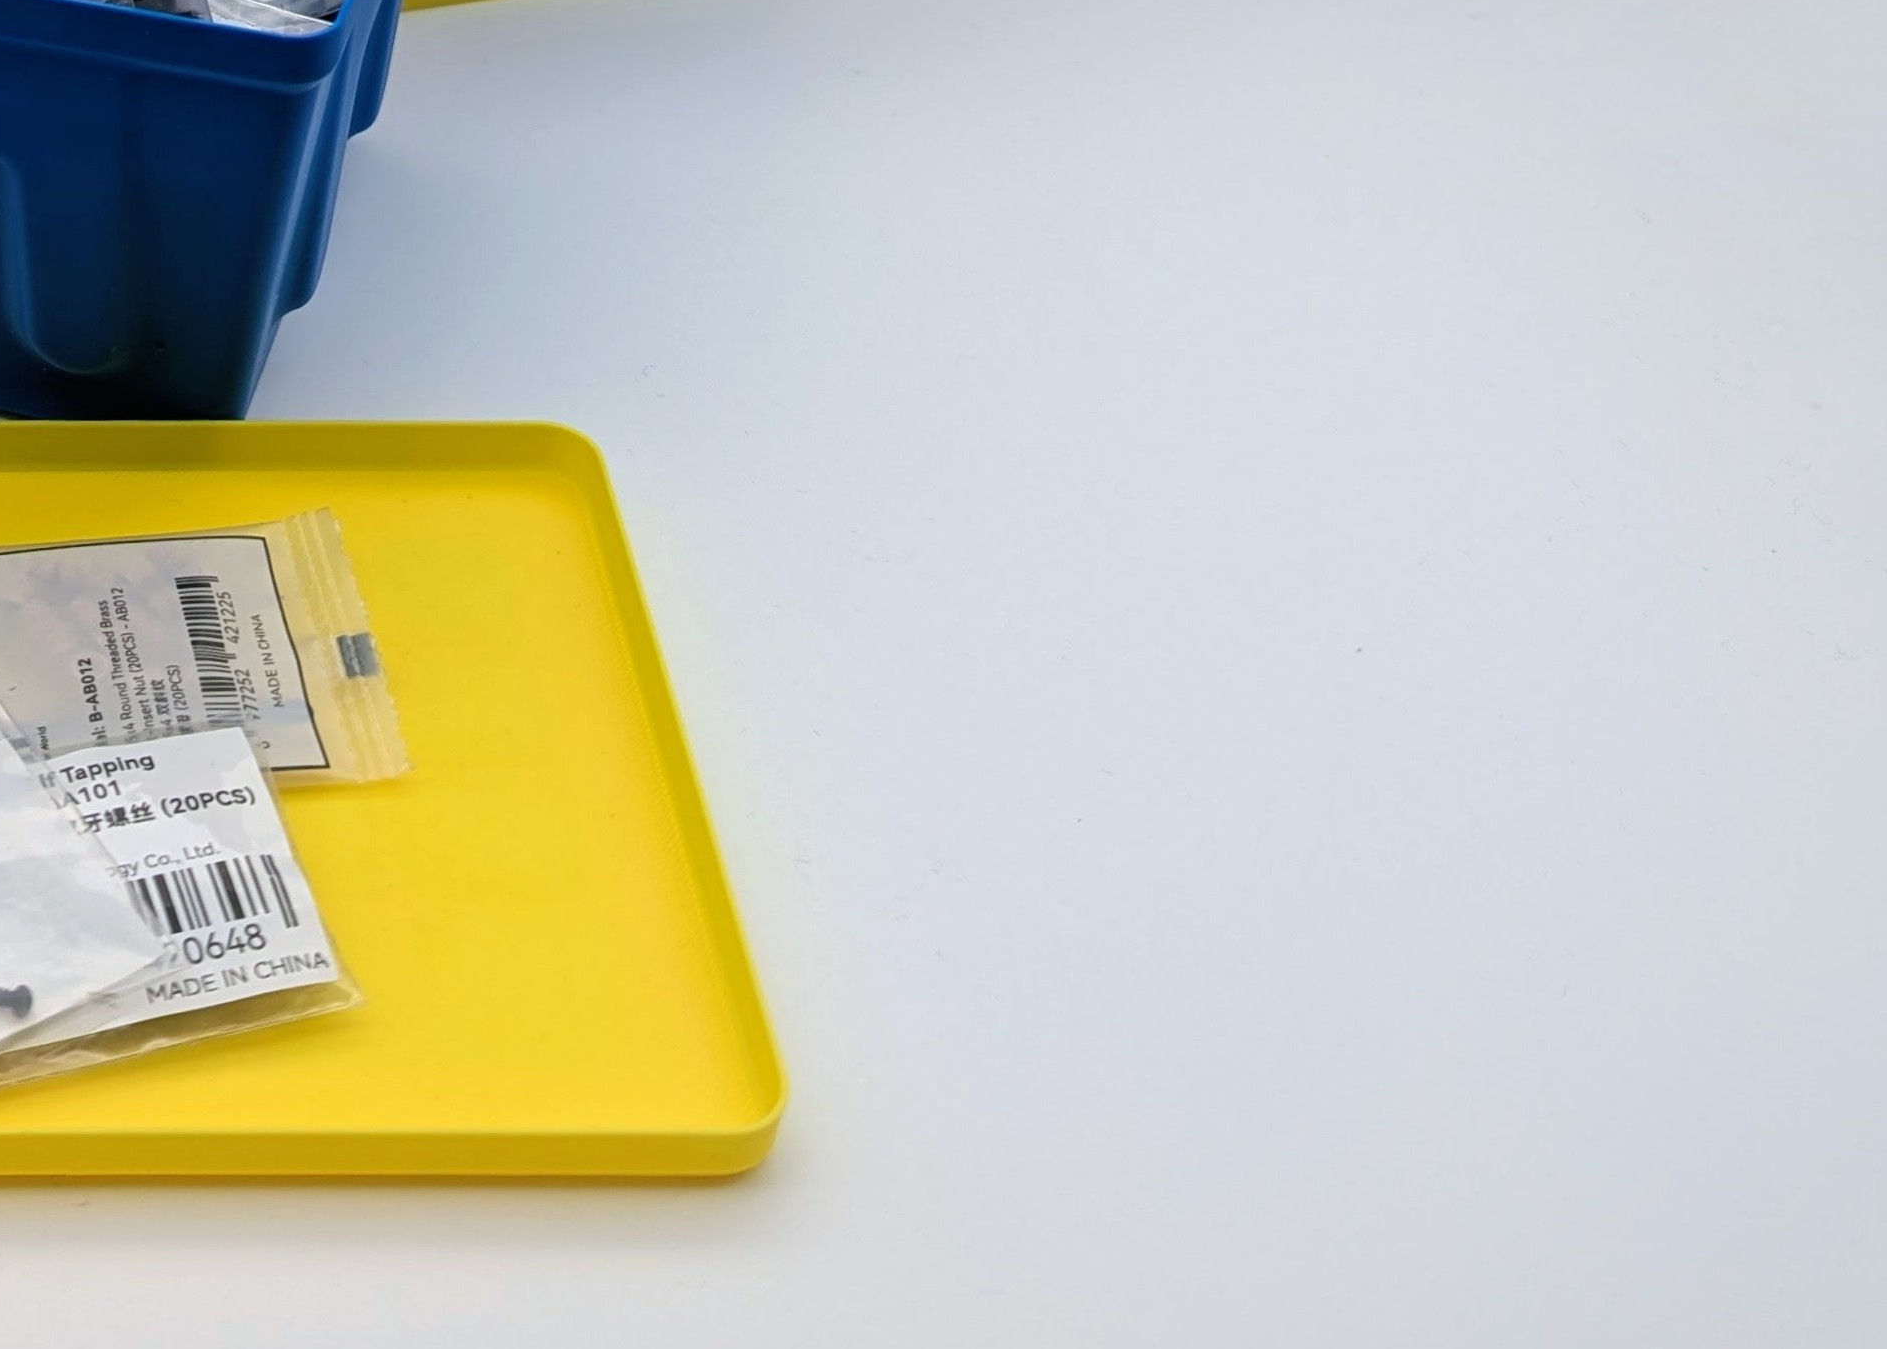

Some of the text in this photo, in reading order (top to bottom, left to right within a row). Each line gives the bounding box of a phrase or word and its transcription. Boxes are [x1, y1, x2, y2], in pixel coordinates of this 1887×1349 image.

[98, 600, 113, 628] Brass
[111, 588, 129, 623] AB012
[218, 591, 239, 644] 421225
[105, 627, 124, 680] Threaded
[126, 631, 143, 673] (20PCS)
[251, 614, 284, 708] MADE IN CHINA
[77, 657, 104, 723] B-AB012
[113, 682, 133, 721] Round
[132, 675, 147, 696] Nut
[166, 665, 189, 711] (20PCS)
[60, 755, 156, 784] Tapping
[161, 786, 256, 819] (20PCS)
[183, 842, 223, 861] Ltd.
[145, 951, 330, 1004] MADE IN CHINA
